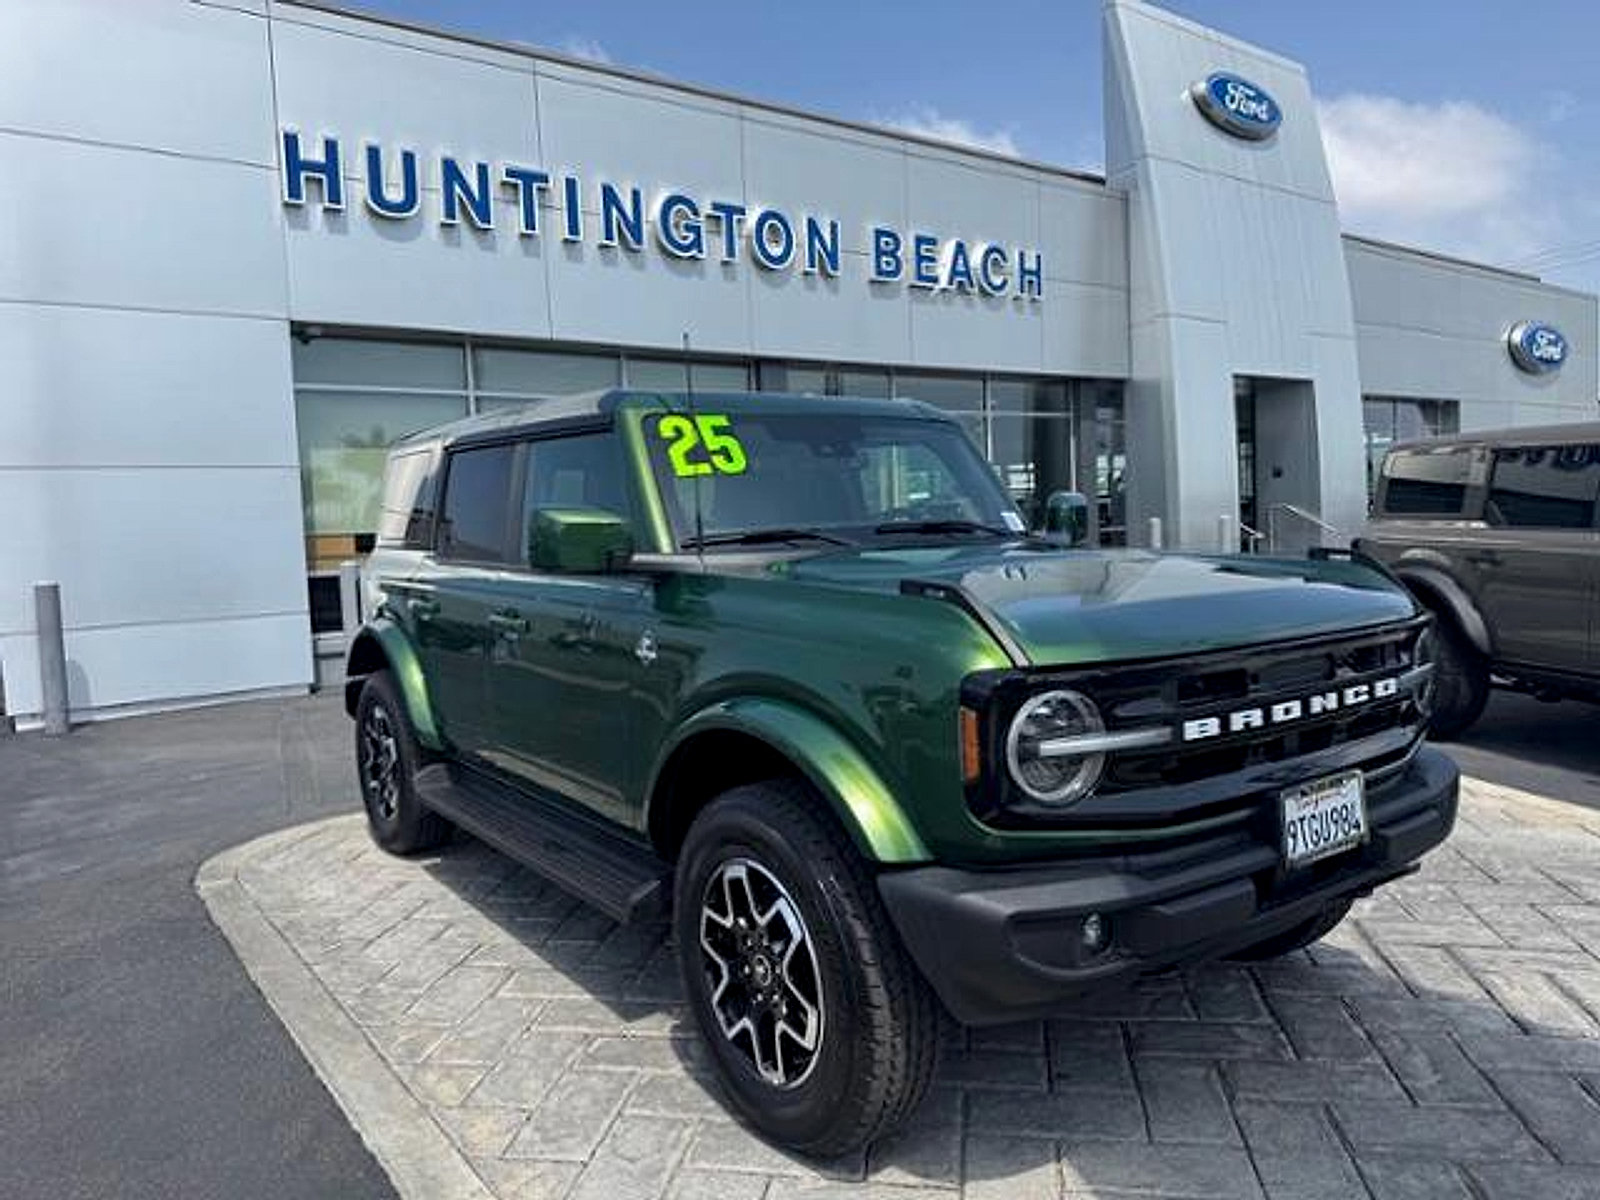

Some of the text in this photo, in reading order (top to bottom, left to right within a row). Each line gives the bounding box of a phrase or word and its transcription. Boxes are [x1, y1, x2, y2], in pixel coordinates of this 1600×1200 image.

[1224, 82, 1268, 121] Ford
[281, 130, 1044, 299] HUNTINGTON BEACH
[1533, 329, 1562, 360] Ford
[658, 414, 747, 476] 25
[1183, 678, 1398, 741] BRONCO
[1287, 803, 1361, 853] 9TGU984
